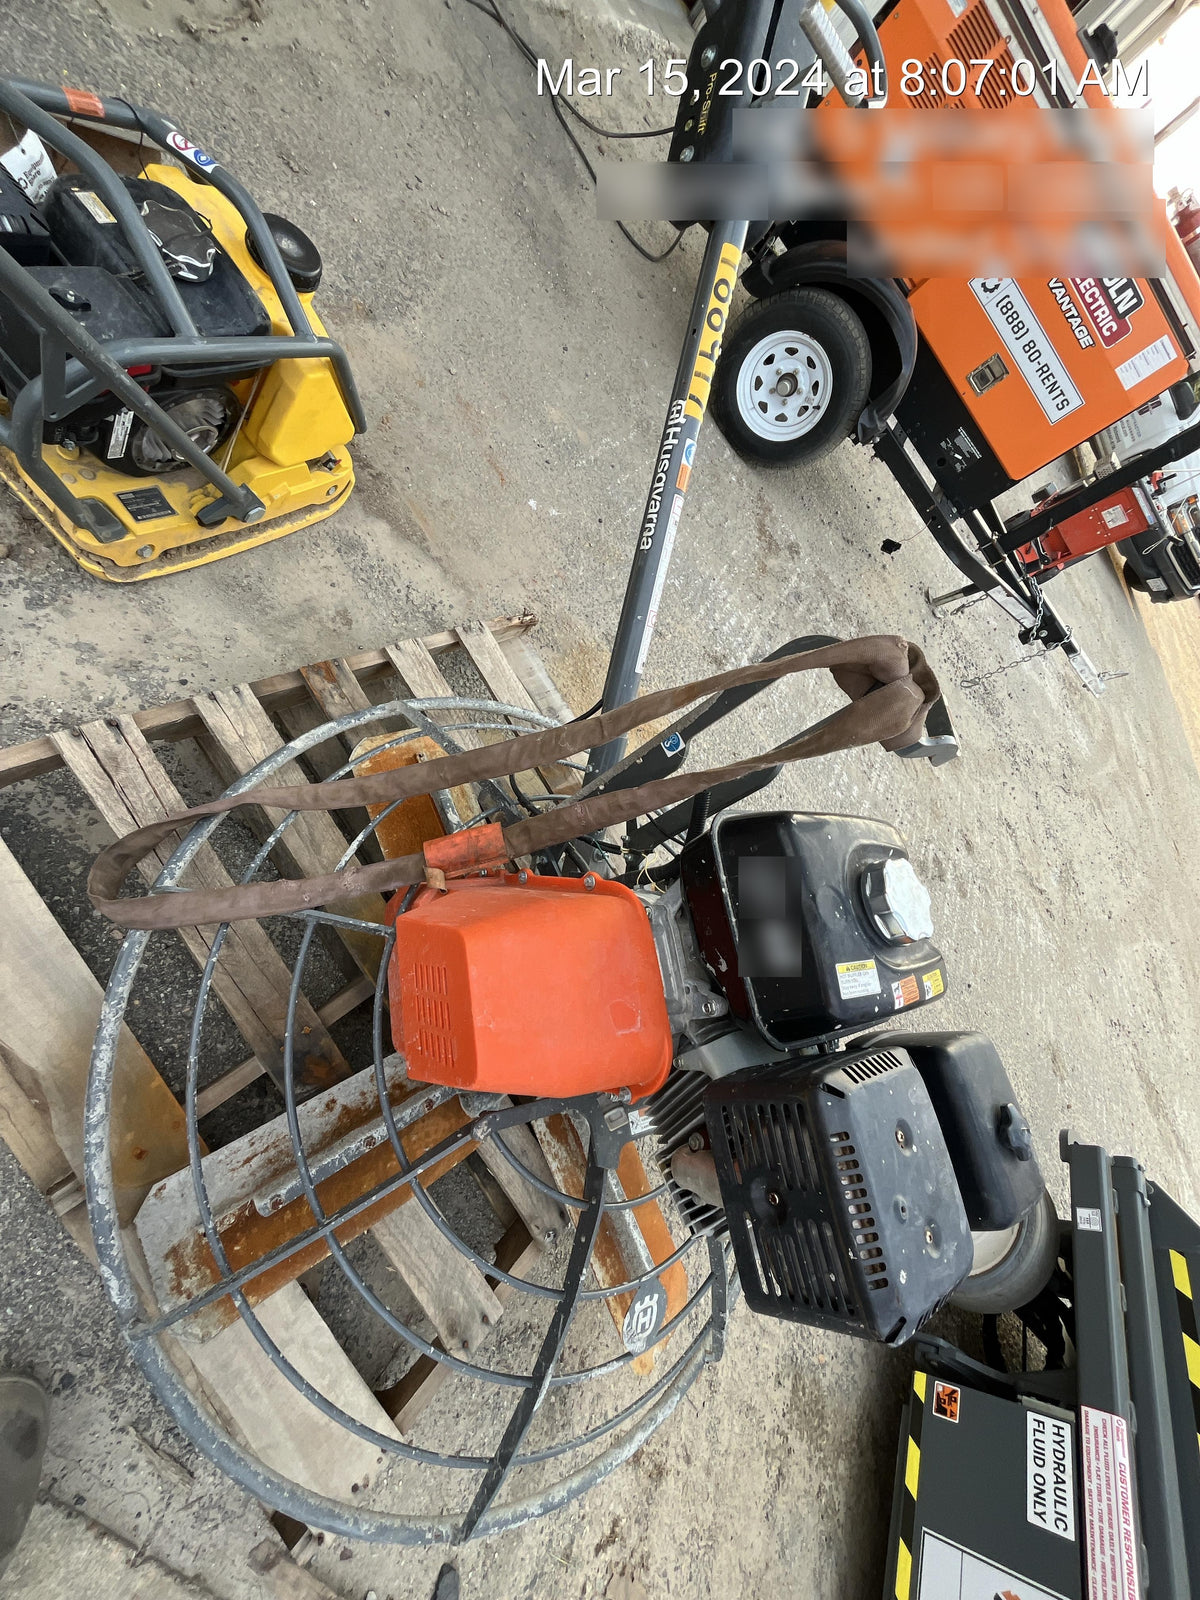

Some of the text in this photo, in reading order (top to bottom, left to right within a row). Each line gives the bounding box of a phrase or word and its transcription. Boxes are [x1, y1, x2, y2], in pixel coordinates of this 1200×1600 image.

[996, 294, 1070, 412] (888) 80-RENTS
[1048, 278, 1096, 350] VANTAGE
[640, 427, 682, 550] Husqvarna
[1032, 1418, 1047, 1524] FLUID ONLY
[1052, 1423, 1068, 1533] HYDRAULIC
[1118, 1462, 1131, 1526] CUSTOMER
